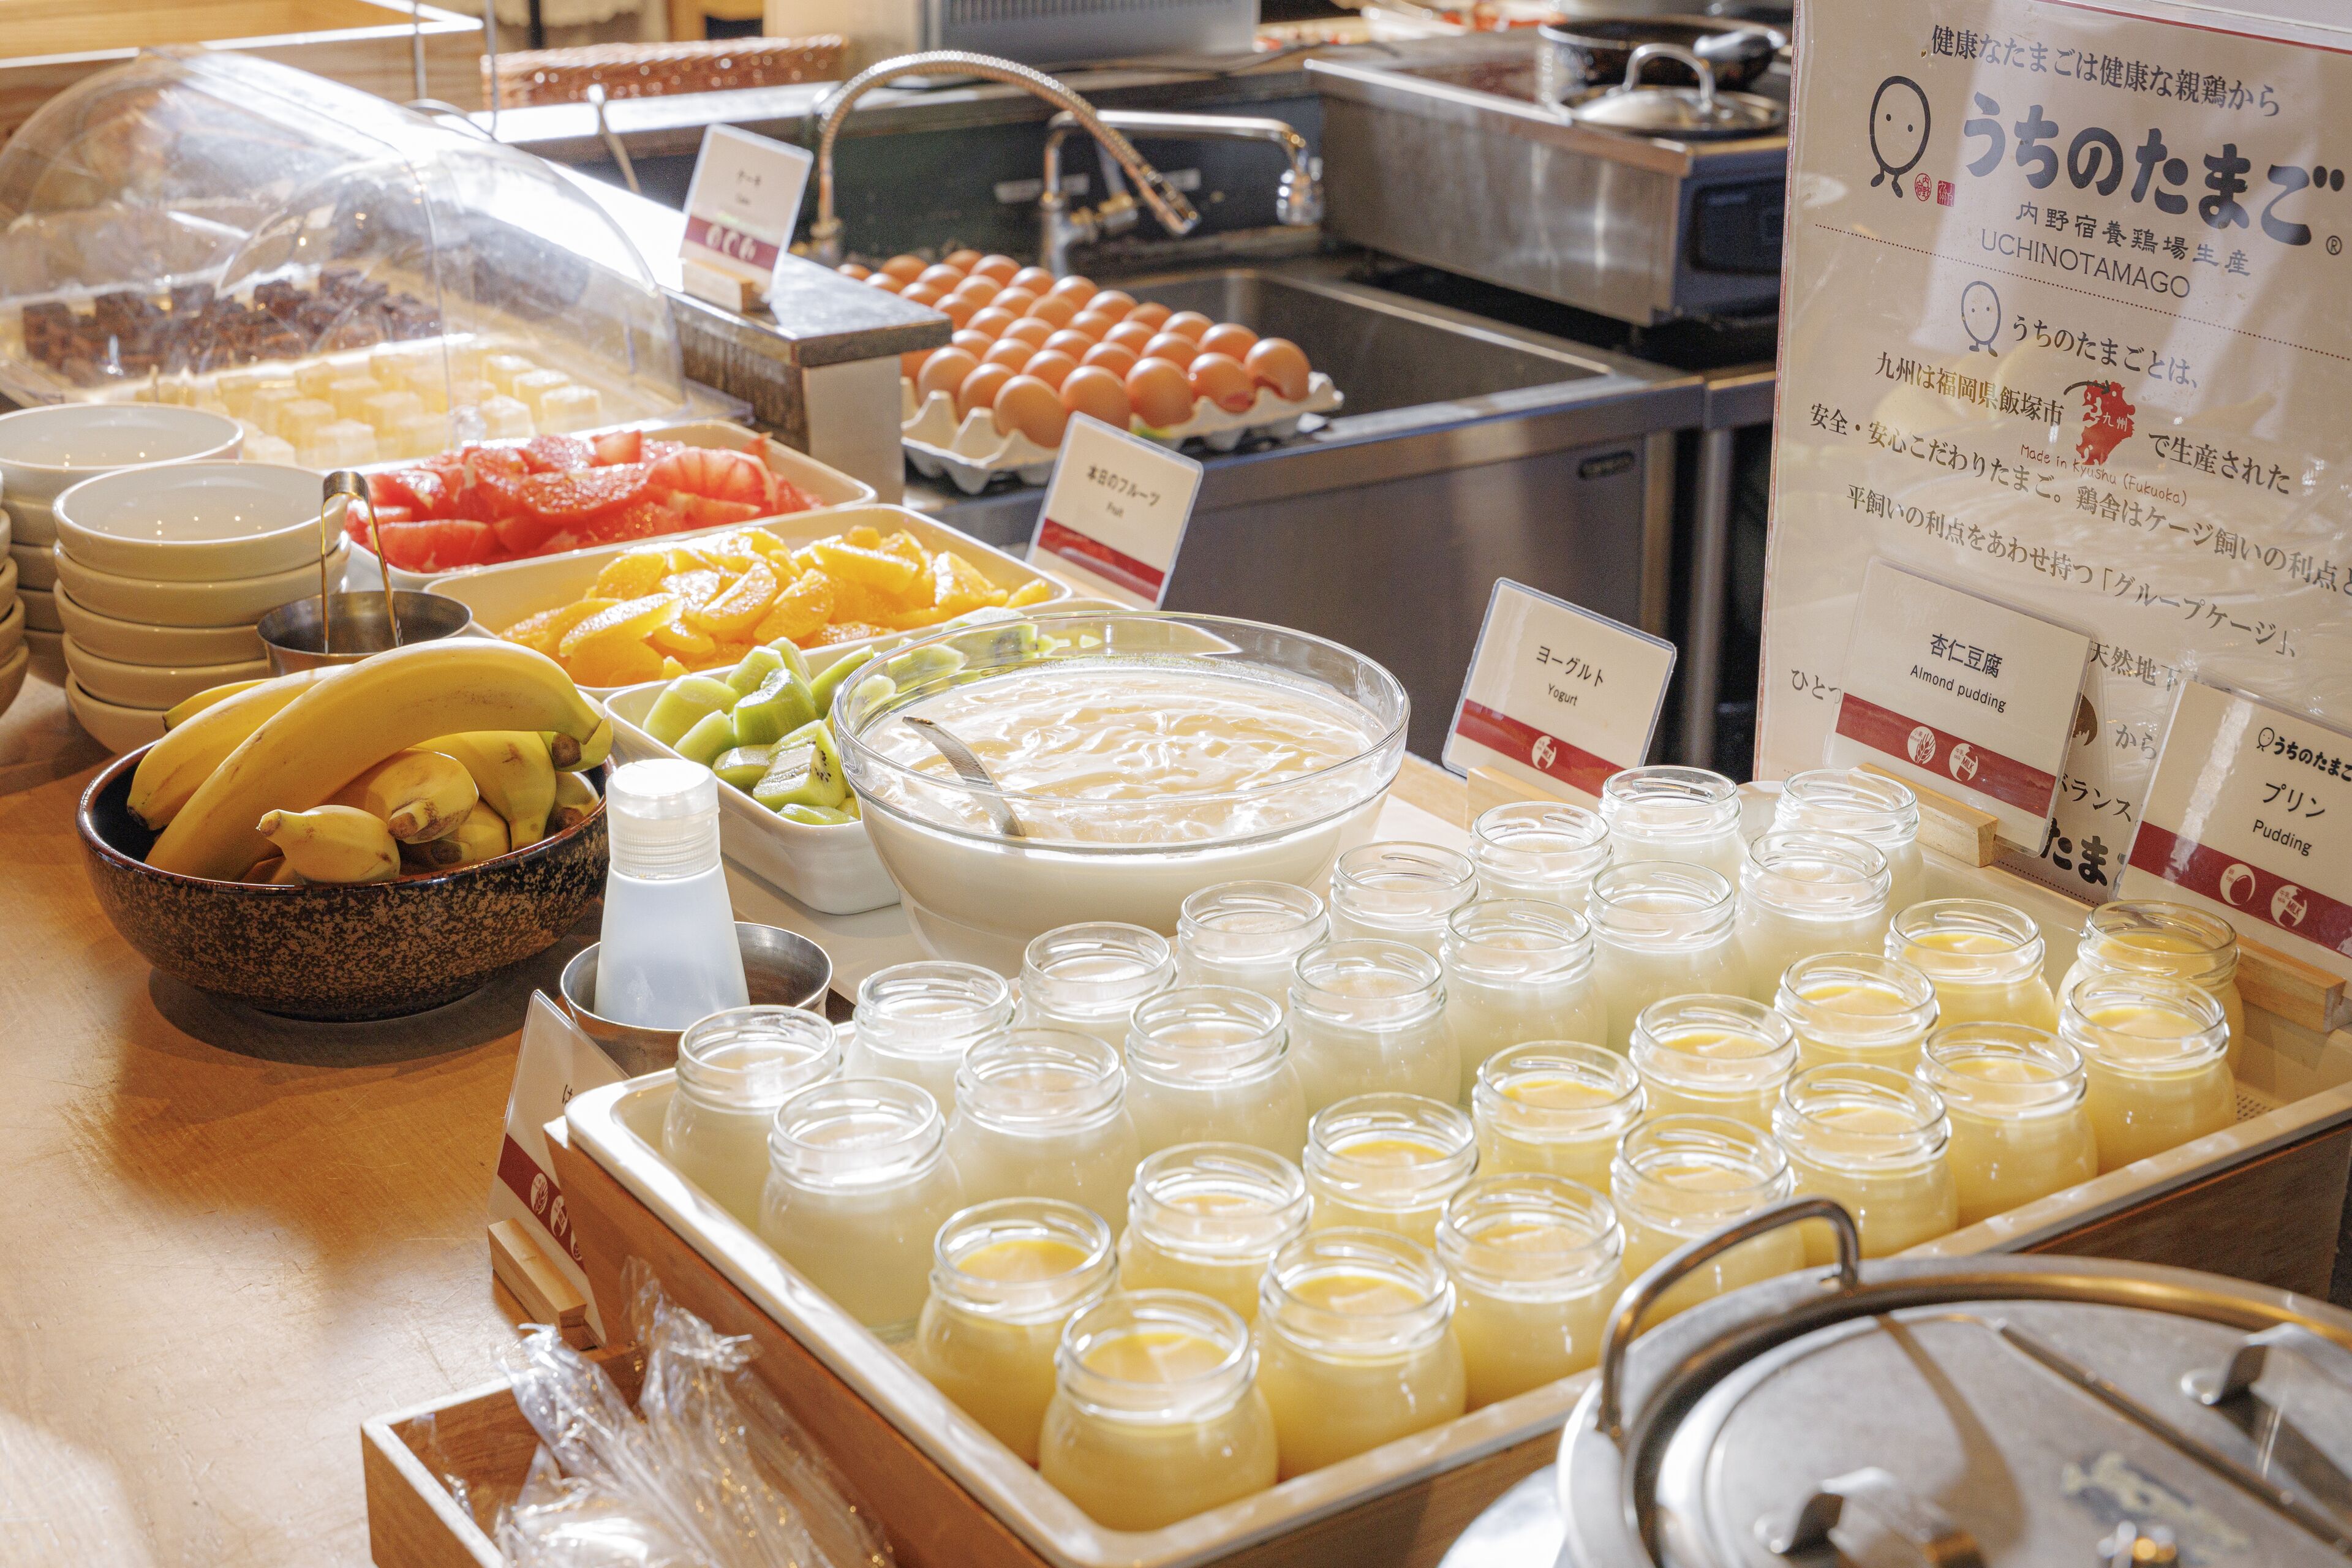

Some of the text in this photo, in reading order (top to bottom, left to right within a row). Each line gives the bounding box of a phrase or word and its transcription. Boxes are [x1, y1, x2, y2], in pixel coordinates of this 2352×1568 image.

[1931, 24, 2280, 116] 健康なたまごは健康な親鶏から
[1964, 91, 2345, 246] うちのたまご
[2016, 201, 2251, 277] 内野宿養鶏場生産
[1981, 228, 2190, 299] UCHINOTAMAGO
[2013, 314, 2198, 389] うちのたまごとは、
[1875, 351, 2290, 495] 九州は福岡県飯塚市 で生産された
[2102, 412, 2128, 432] 九州
[2021, 444, 2051, 464] Made
[2056, 456, 2067, 469] in
[2123, 473, 2187, 507] (Fukuoka)
[1536, 645, 1604, 687] ヨーグルト
[1930, 633, 2003, 678] 杏仁豆腐
[1547, 683, 1578, 706] Yogurt
[1910, 665, 2007, 714] Almond pudding
[1961, 756, 1975, 772] MILK
[2115, 724, 2157, 760] から
[2262, 782, 2326, 818] プリン
[2252, 819, 2313, 857] Pudding
